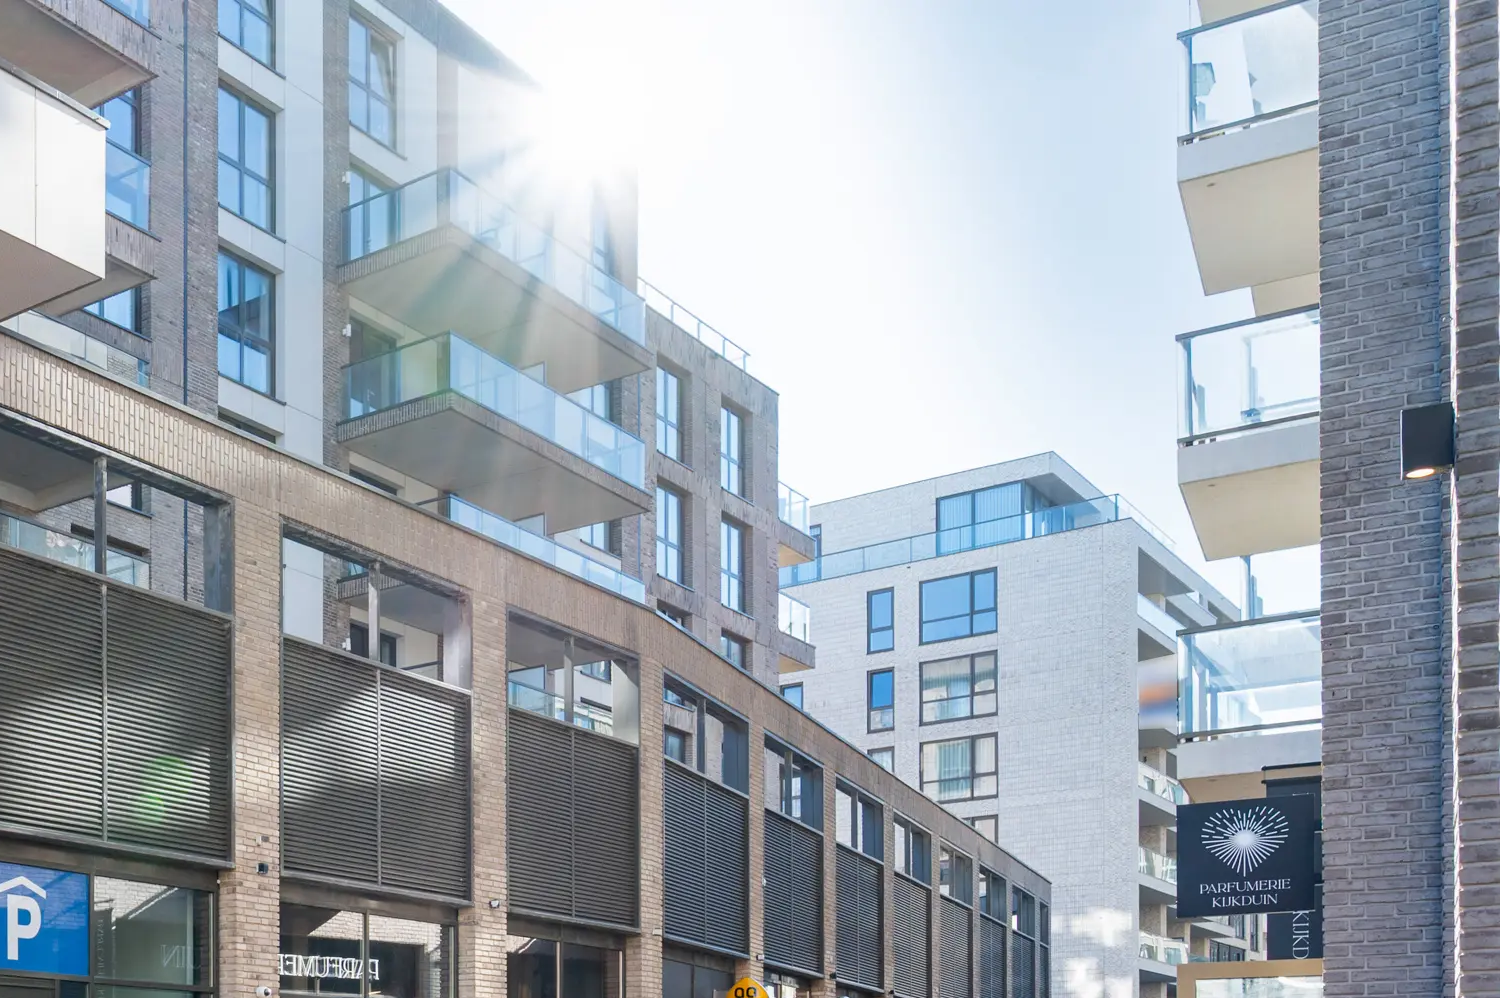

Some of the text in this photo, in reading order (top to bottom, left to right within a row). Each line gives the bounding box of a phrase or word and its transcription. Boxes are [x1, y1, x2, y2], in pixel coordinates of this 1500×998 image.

[1199, 878, 1291, 895] PARFUMERIE
[1212, 893, 1278, 908] KIJKDUIN
[7, 893, 42, 961] P
